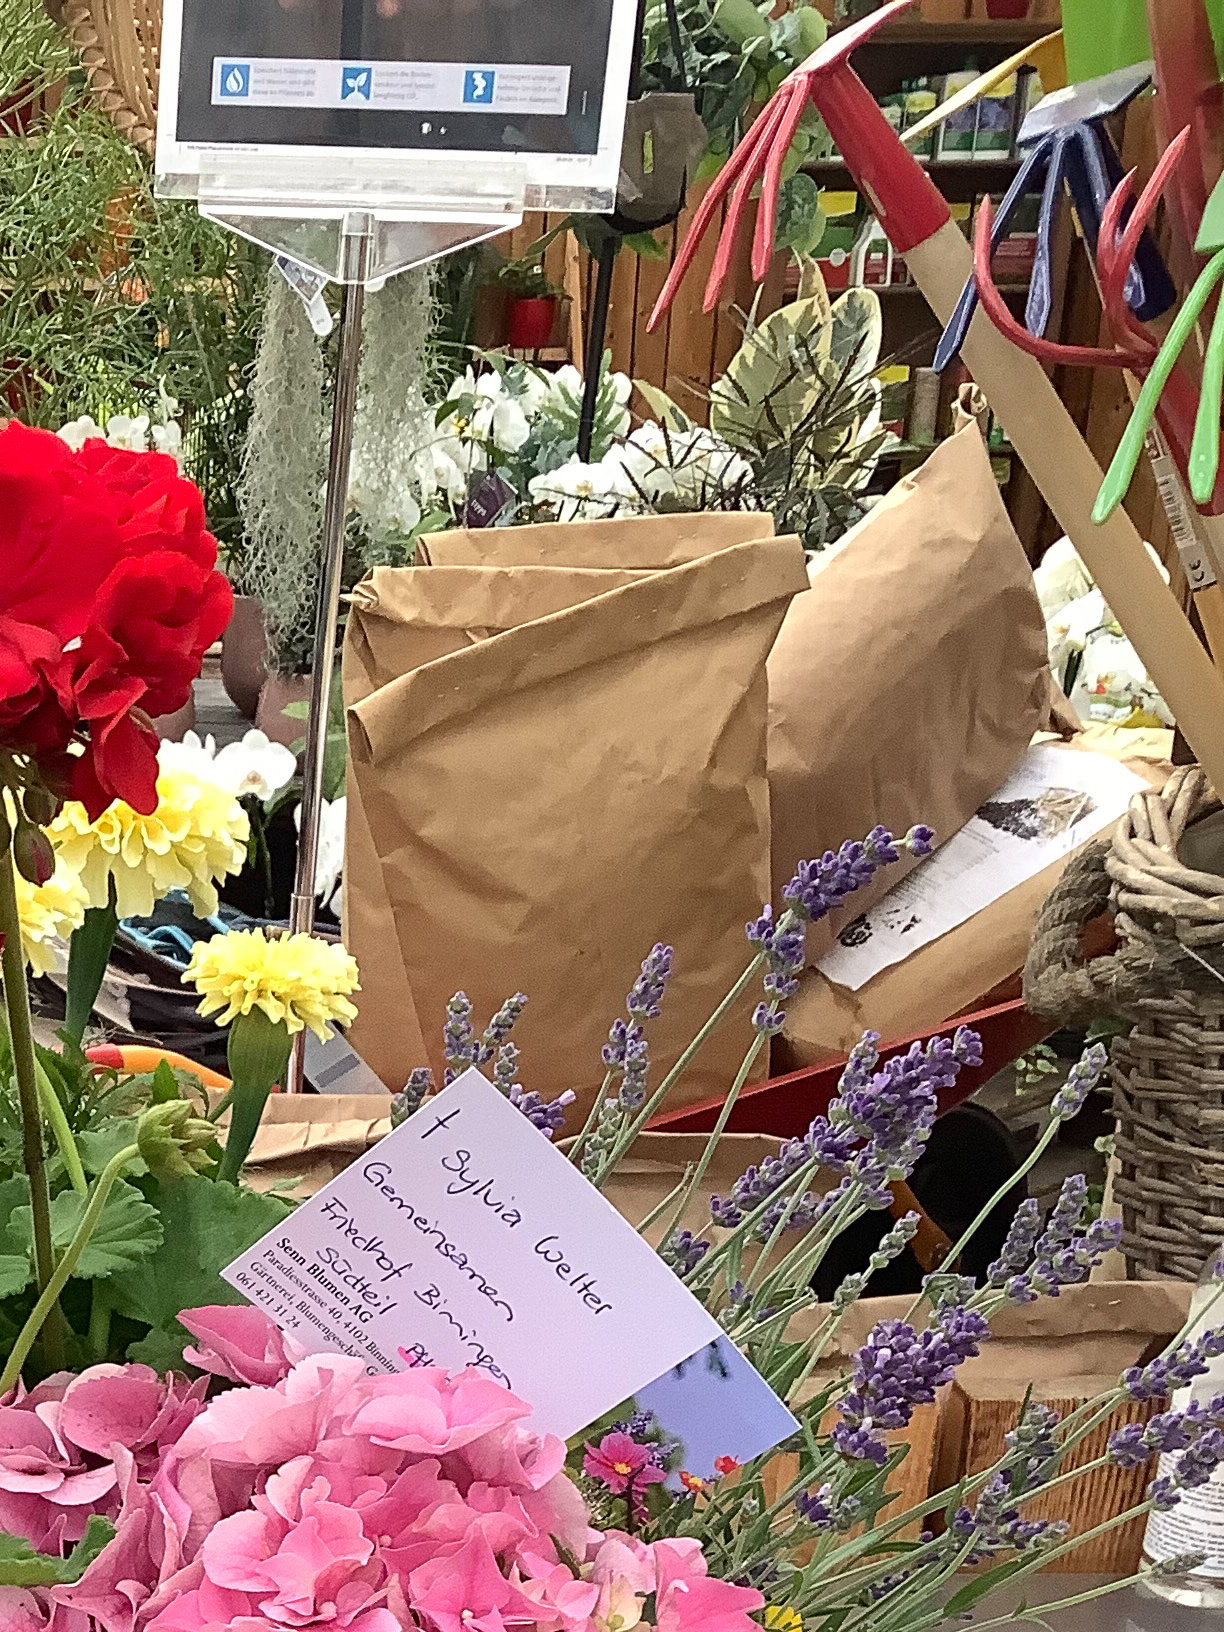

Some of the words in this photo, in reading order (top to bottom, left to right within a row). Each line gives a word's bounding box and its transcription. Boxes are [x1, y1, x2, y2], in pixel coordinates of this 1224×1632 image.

[320, 1196, 413, 1282] Friedhof
[441, 1149, 522, 1228] Sylvia
[534, 1235, 613, 1315] Welter
[235, 1271, 256, 1290] 061
[255, 1289, 274, 1306] 421
[273, 1303, 288, 1317] 31
[285, 1315, 301, 1329] 24
[262, 1249, 328, 1308] Paradiesstrasse
[343, 1321, 369, 1344] 4102
[277, 1237, 306, 1266] Senn
[306, 1263, 351, 1306] Blumen
[349, 1303, 374, 1324] AG
